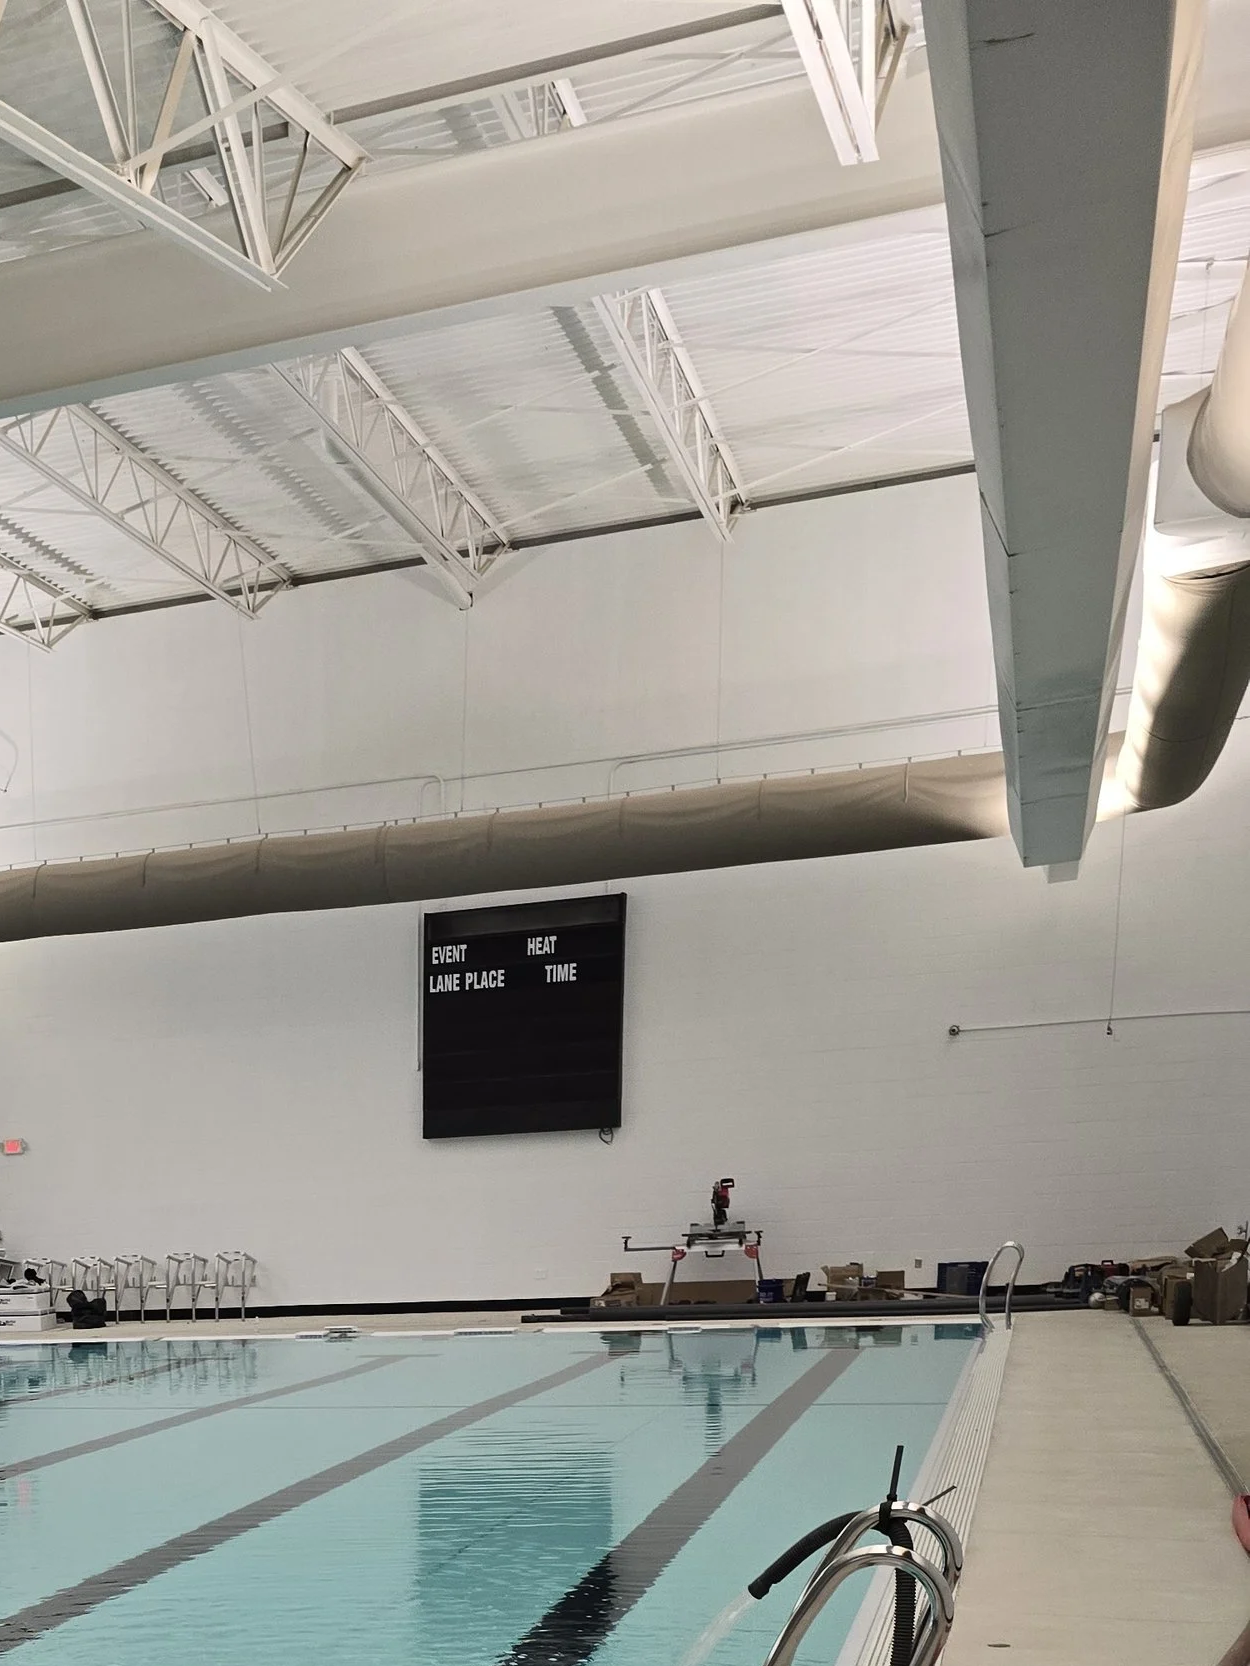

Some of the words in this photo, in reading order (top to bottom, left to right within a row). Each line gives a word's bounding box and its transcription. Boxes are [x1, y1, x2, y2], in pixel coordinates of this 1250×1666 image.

[432, 944, 467, 965] EVENT
[527, 935, 557, 956] HEAT
[429, 973, 460, 993] LANE
[465, 969, 505, 991] PLACE
[544, 962, 577, 983] TIME
